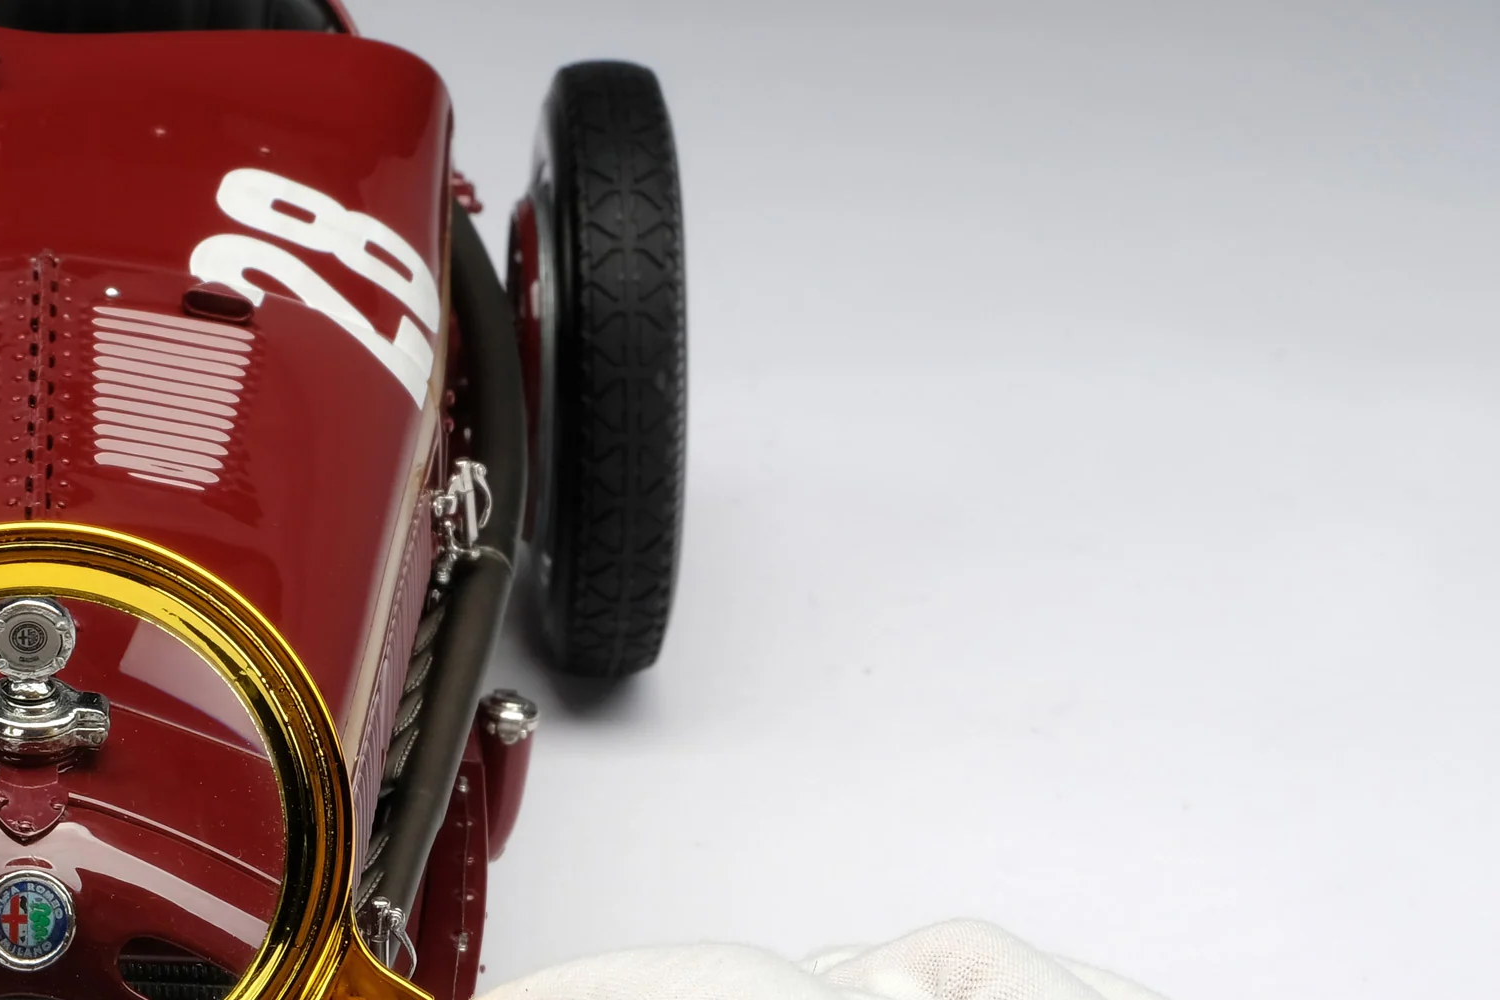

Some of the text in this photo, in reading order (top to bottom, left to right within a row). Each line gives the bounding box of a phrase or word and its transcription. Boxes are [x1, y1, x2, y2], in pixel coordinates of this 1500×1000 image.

[189, 167, 440, 409] 28
[27, 882, 64, 919] ROMEO
[0, 939, 53, 958] MILANO
